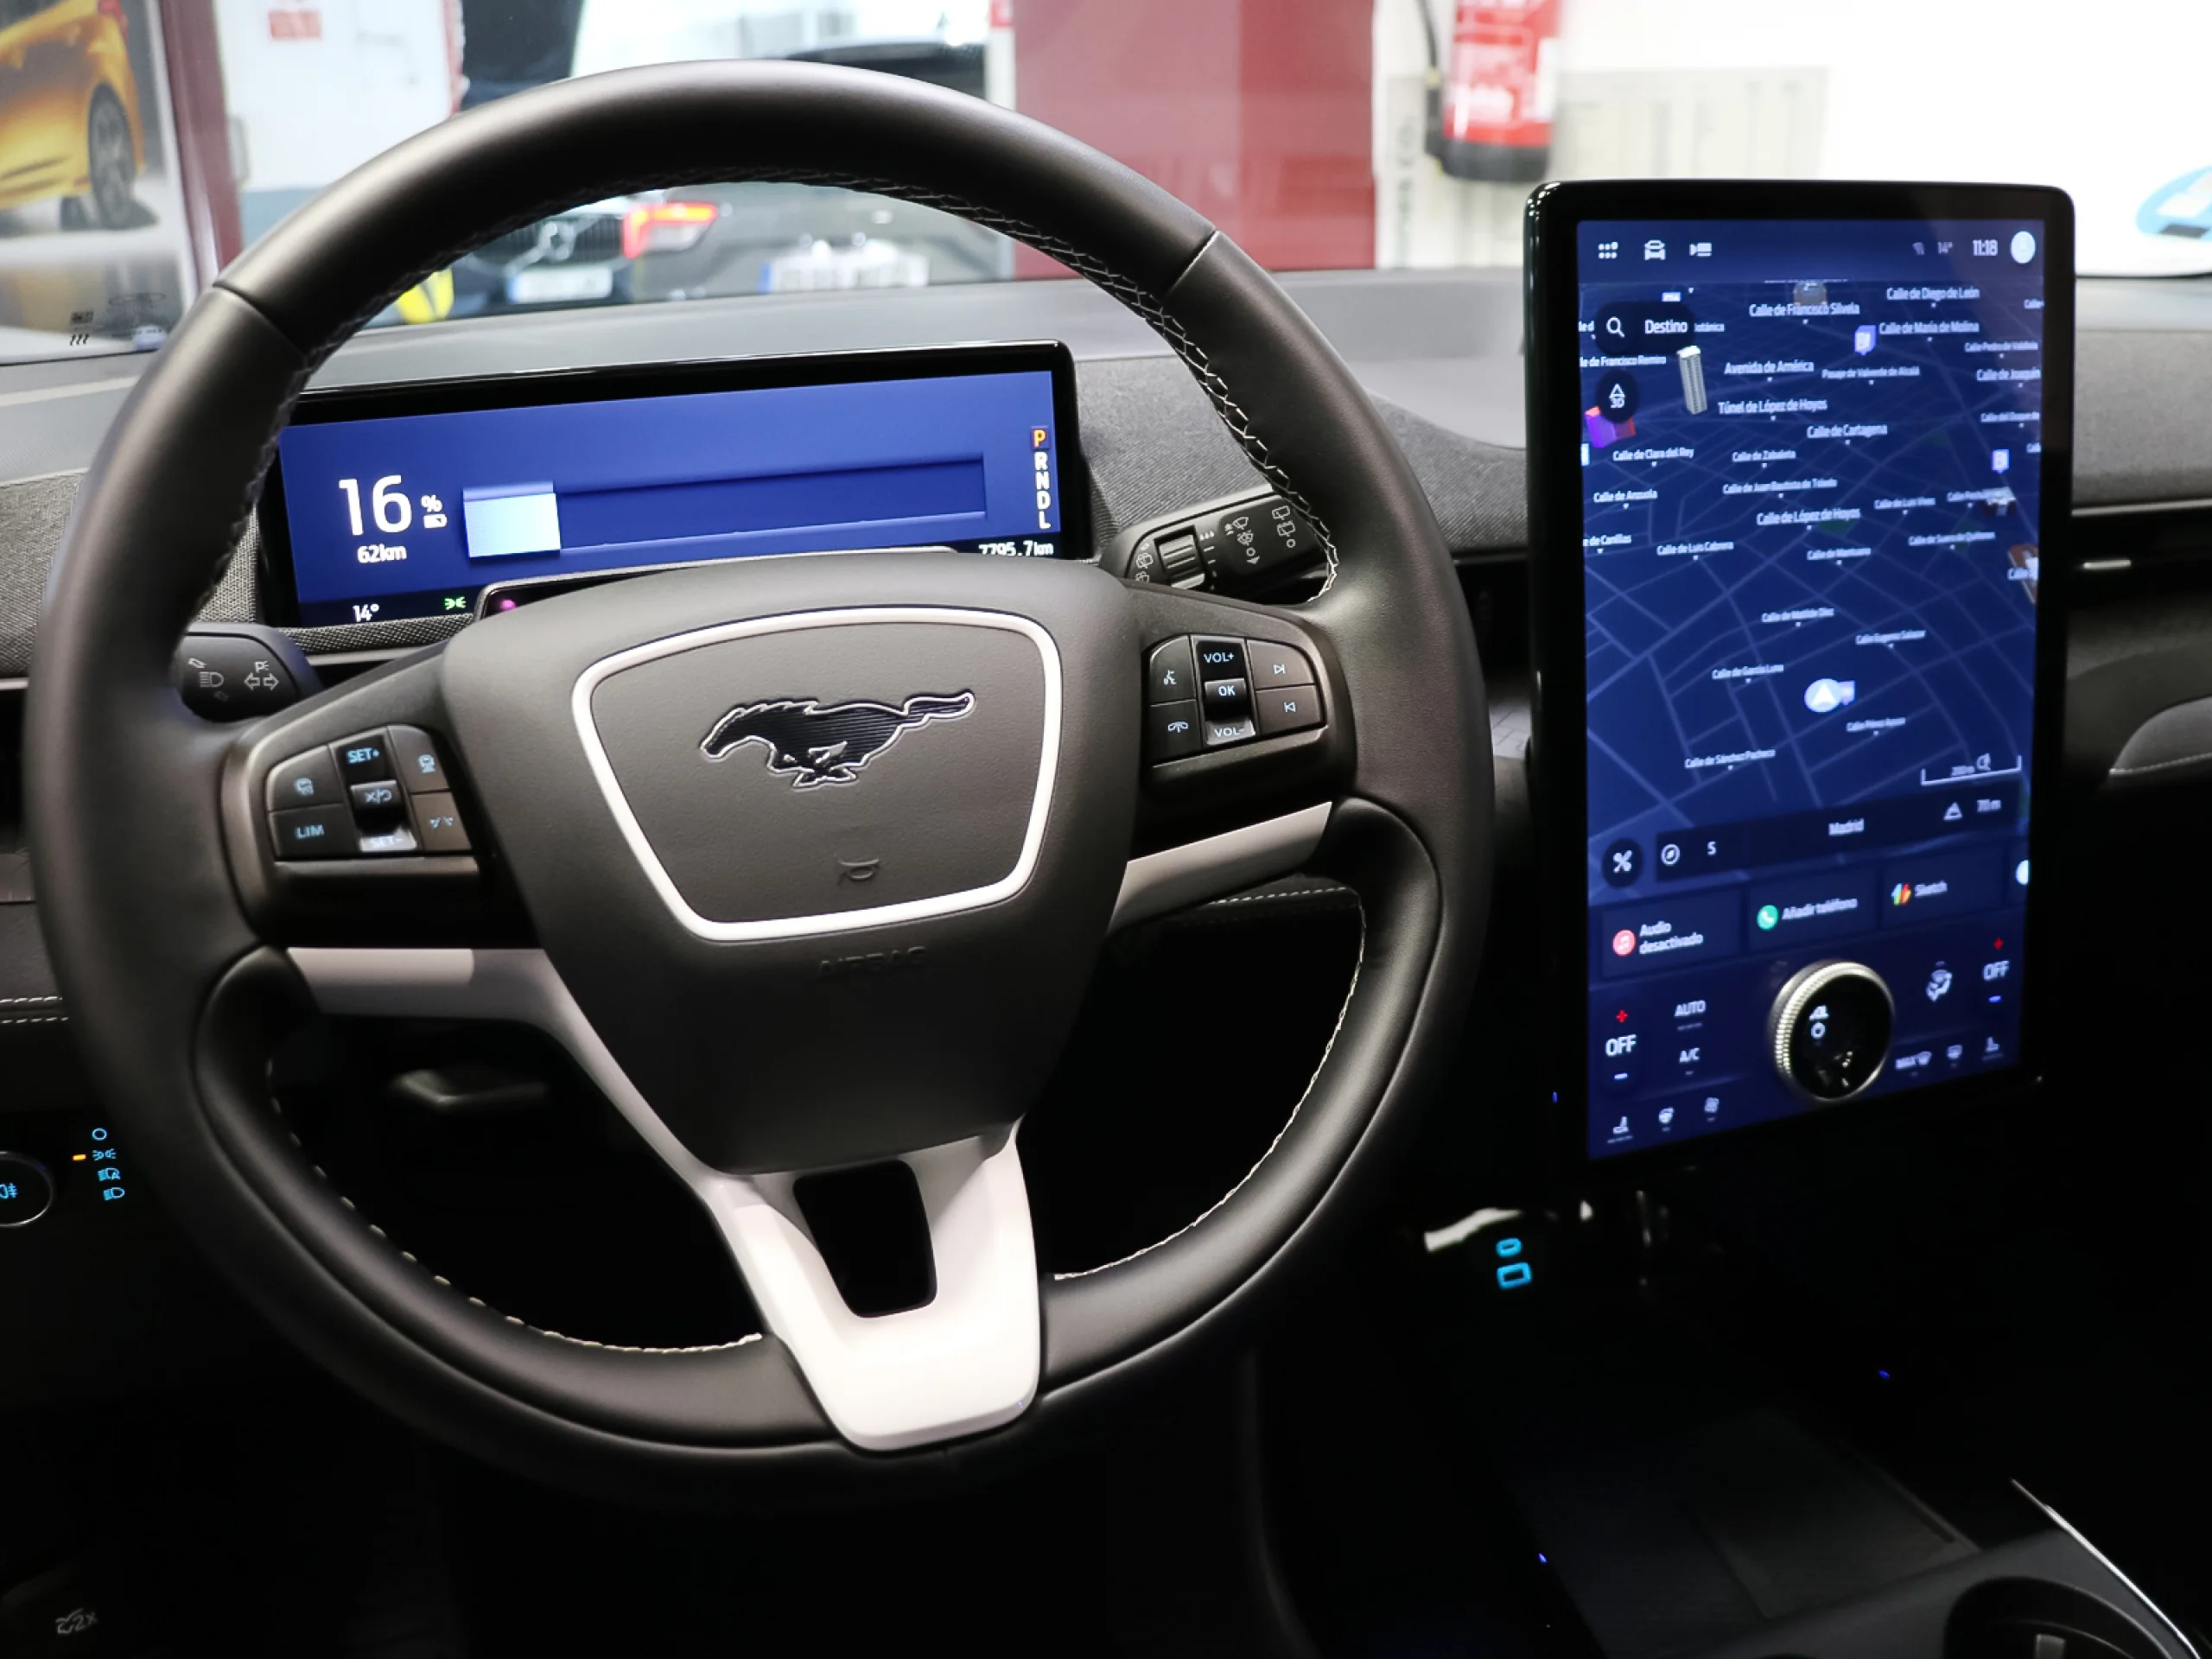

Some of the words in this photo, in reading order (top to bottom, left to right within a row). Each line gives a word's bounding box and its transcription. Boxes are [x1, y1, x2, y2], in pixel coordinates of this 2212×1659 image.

[1973, 239, 1999, 257] 11:18
[1886, 288, 1908, 300] Calle
[1910, 288, 1921, 299] de
[1946, 287, 1957, 299] de
[1749, 303, 1772, 317] Calle
[1774, 304, 1786, 315] de
[1644, 319, 1688, 334] Destino
[1879, 322, 1900, 334] Calle
[1902, 322, 1912, 334] de
[1939, 321, 1949, 333] de
[1724, 361, 1763, 375] Avenida
[1763, 360, 1777, 374] de
[1977, 369, 1998, 381] Calle
[1999, 368, 2009, 380] de
[1718, 401, 1745, 415] Túnel
[1745, 401, 1758, 413] de
[1787, 399, 1798, 411] de
[1799, 398, 1827, 412] Hoyos
[1033, 429, 1046, 448] P
[1807, 425, 1829, 439] Calle
[1831, 424, 1842, 437] de
[1843, 423, 1888, 438] Cartagena
[1034, 451, 1048, 471] R
[1613, 450, 1633, 461] Calle
[1634, 449, 1644, 460] de
[1732, 451, 1751, 462] Calle
[1036, 471, 1051, 490] N
[1593, 492, 1614, 503] Calle
[1615, 491, 1625, 501] de
[1723, 484, 1742, 495] Calle
[339, 474, 412, 536] 16
[421, 495, 442, 512] %
[1037, 490, 1052, 510] D
[1039, 511, 1052, 530] L
[1756, 512, 1780, 526] Calle
[1781, 512, 1793, 524] de
[1821, 508, 1833, 521] de
[357, 543, 407, 563] 62km
[1656, 544, 1676, 556] Calle
[1677, 543, 1688, 555] de
[1204, 652, 1235, 664] VOL+
[1218, 685, 1236, 696] OK
[346, 747, 380, 764] SET+
[296, 823, 325, 839] LIM
[1828, 817, 1865, 836] Madrid
[1707, 841, 1717, 855] S
[1639, 920, 1672, 938] Audio
[1639, 931, 1705, 954] desactivado
[1982, 960, 2010, 982] OFF
[1674, 1000, 1707, 1017] AUTO
[1605, 1034, 1637, 1057] OFF
[1679, 1047, 1700, 1063] A/C
